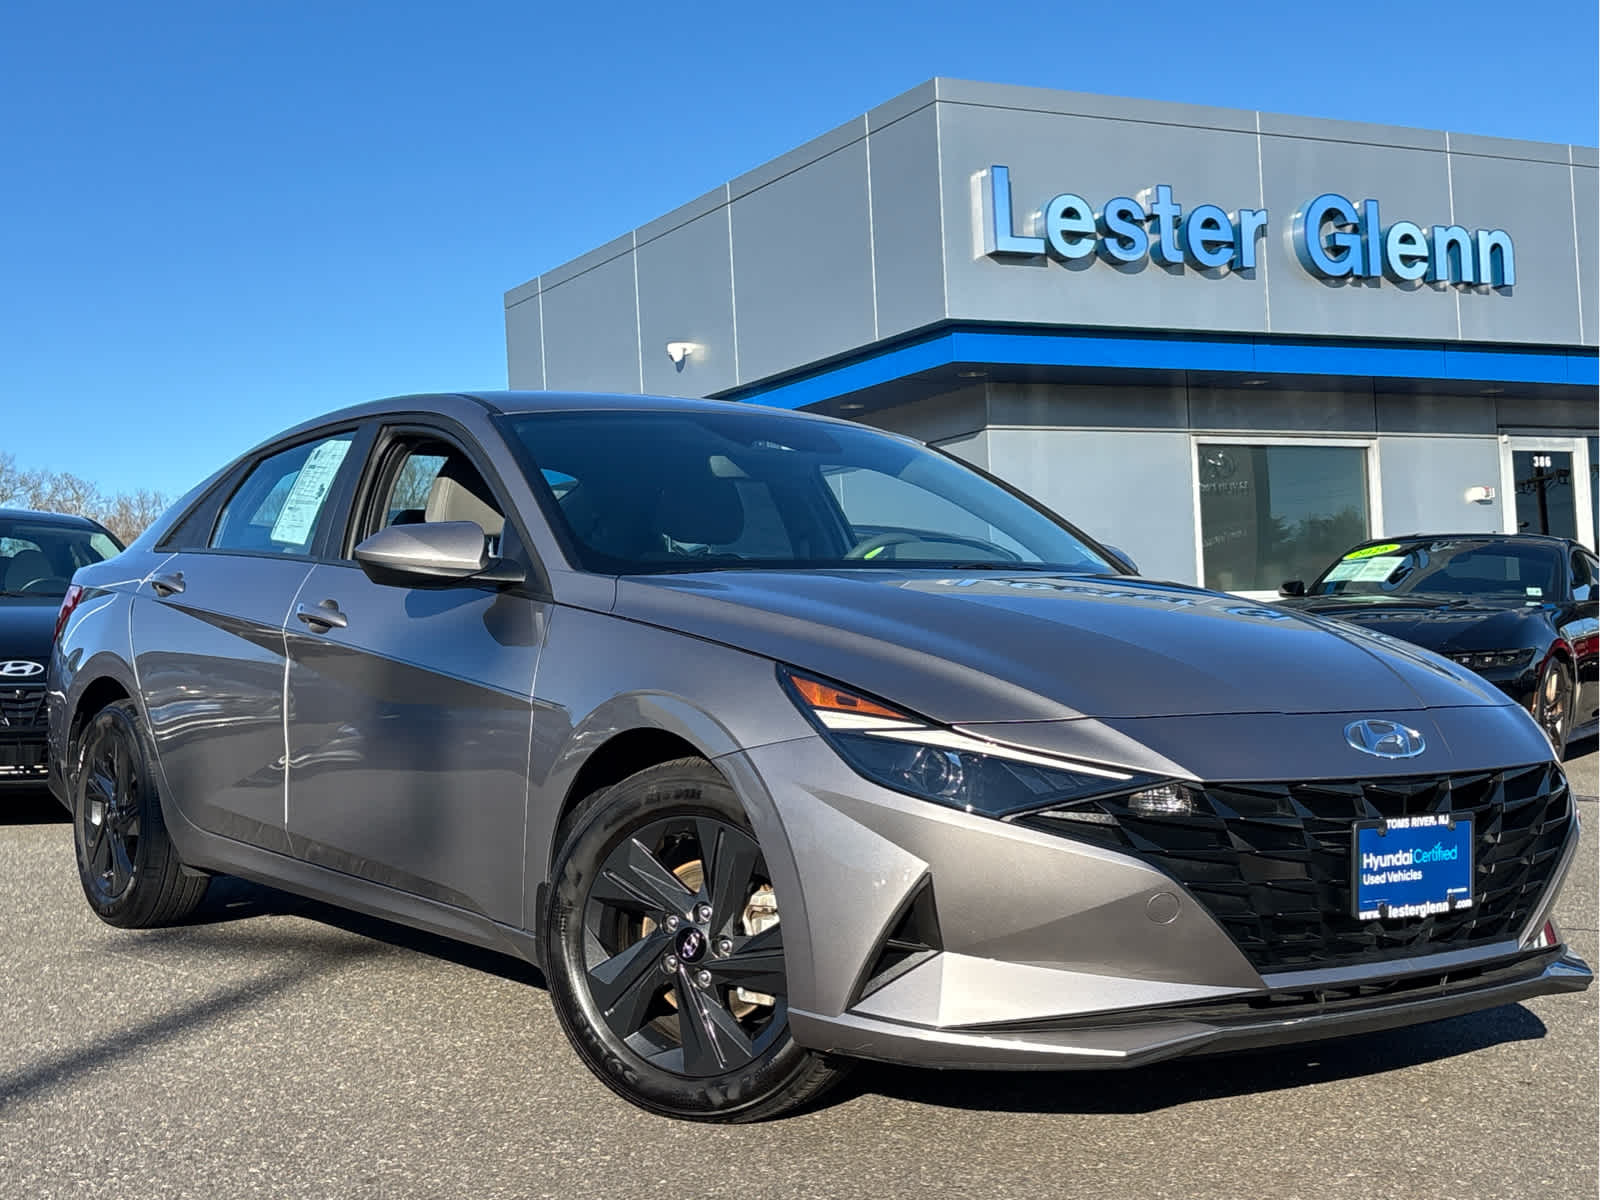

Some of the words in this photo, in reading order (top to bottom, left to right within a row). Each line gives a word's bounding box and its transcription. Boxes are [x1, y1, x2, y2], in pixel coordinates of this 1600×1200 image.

[982, 165, 1267, 271] Lester
[1301, 192, 1516, 288] Glenn
[1532, 455, 1552, 468] 386
[1386, 817, 1410, 829] TOMS
[1438, 814, 1450, 825] NJ
[1362, 849, 1413, 872] Hyundai
[1413, 842, 1458, 864] Certified
[1362, 872, 1387, 886] Used
[1387, 869, 1423, 883] Vehicles
